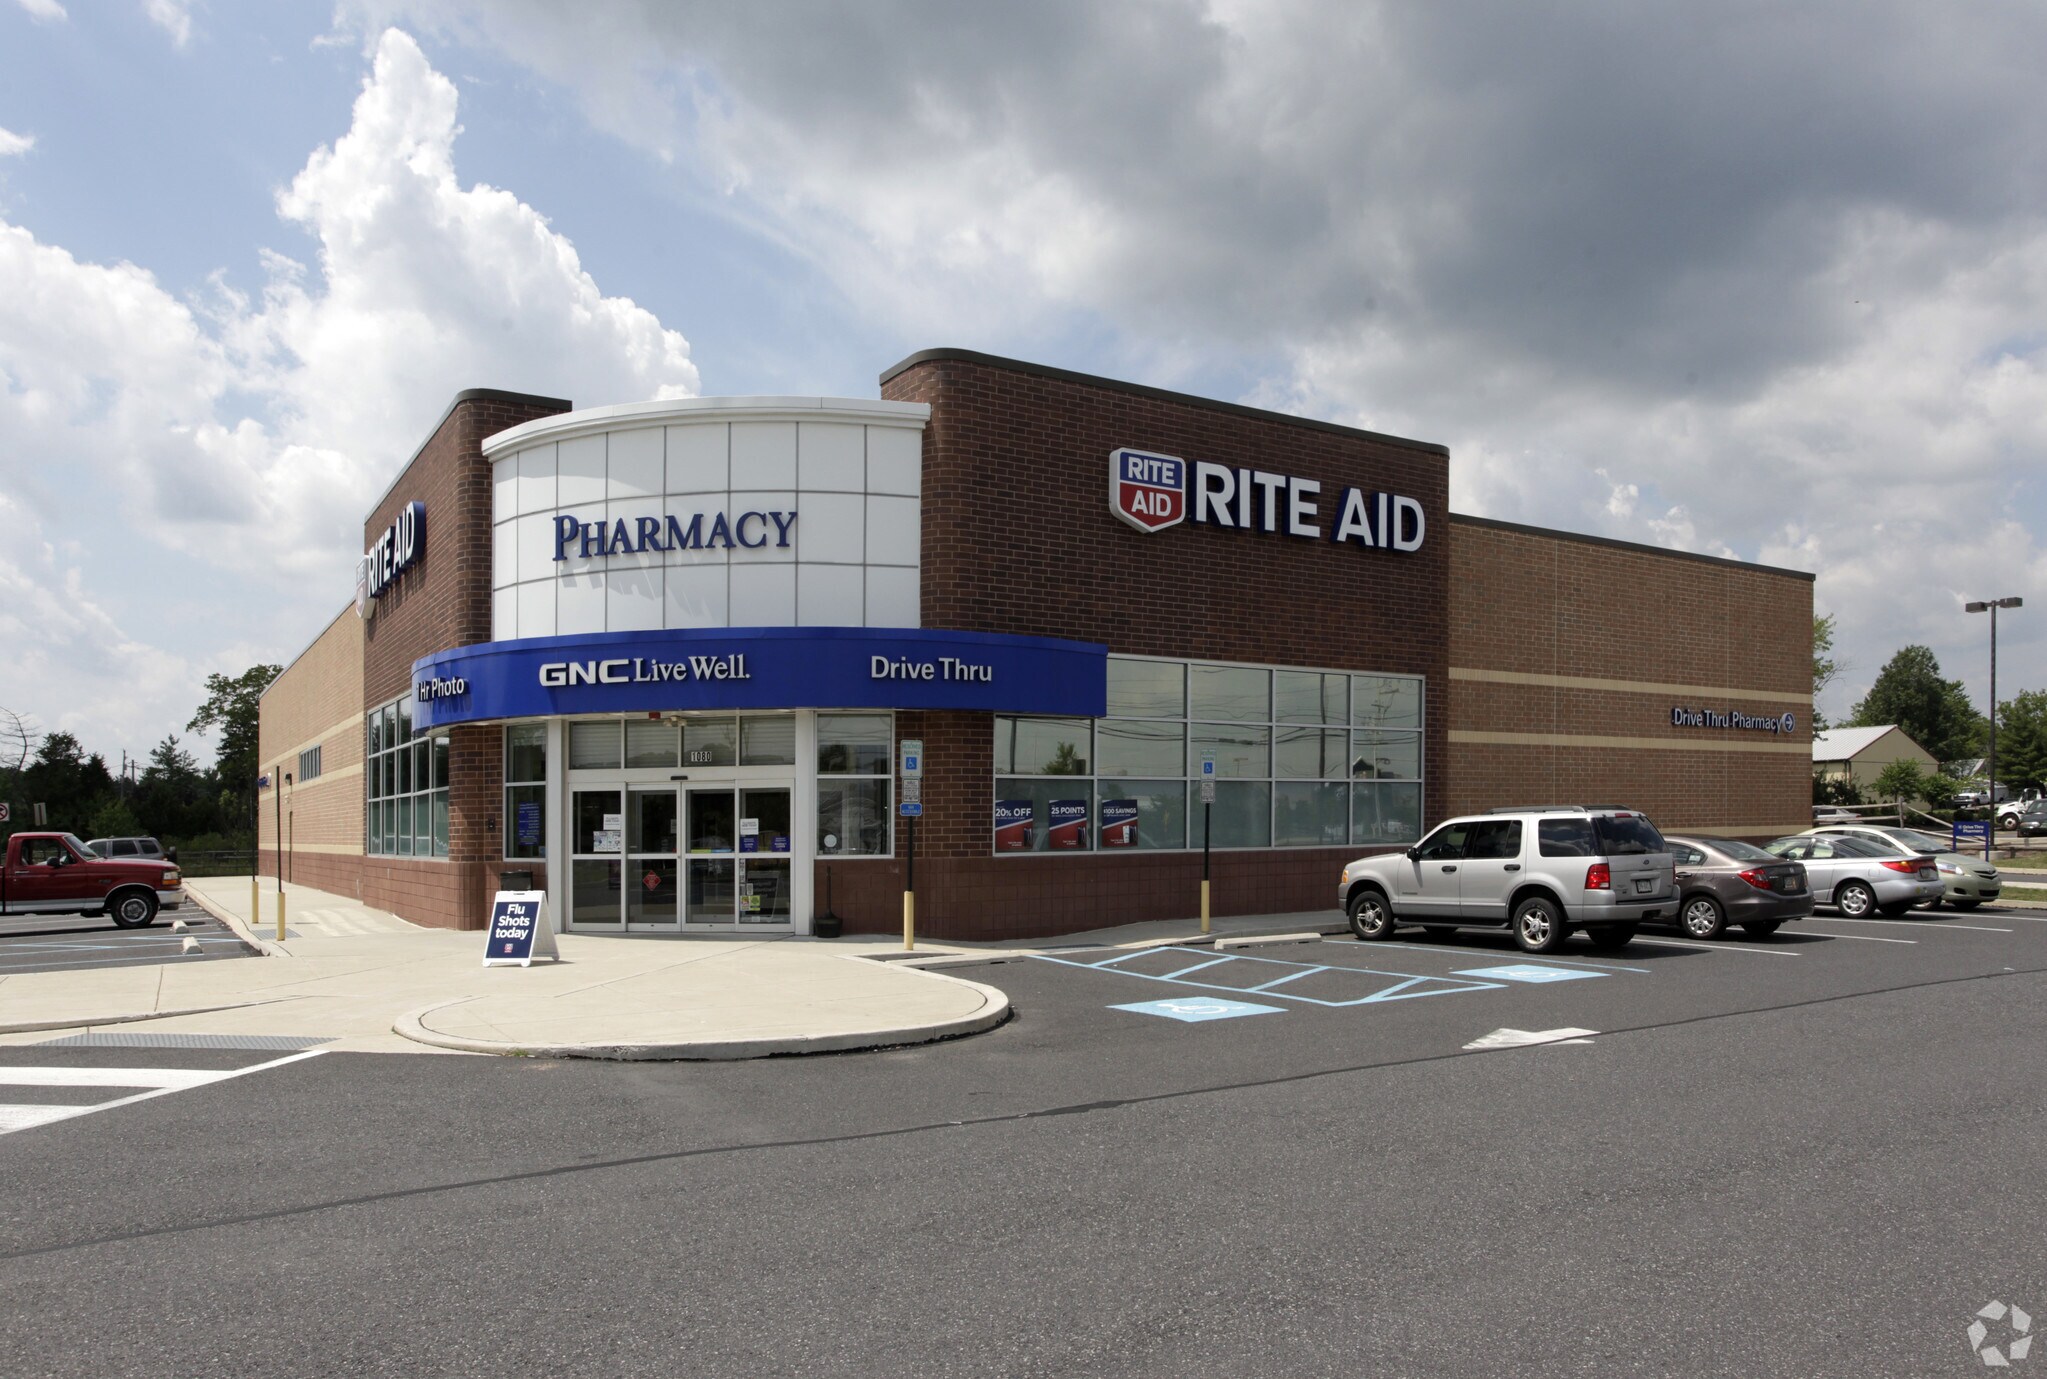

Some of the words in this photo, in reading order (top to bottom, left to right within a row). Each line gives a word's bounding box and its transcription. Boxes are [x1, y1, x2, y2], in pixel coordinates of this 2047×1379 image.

[1127, 456, 1175, 485] RITE
[1131, 490, 1172, 517] AID
[1196, 460, 1321, 538] RITE
[1336, 487, 1426, 552] AID
[368, 526, 391, 598] RITE
[393, 501, 415, 575] AID
[552, 511, 798, 562] PHARMACY
[540, 658, 629, 687] GNC
[633, 657, 687, 682] Live
[688, 653, 751, 681] Well.
[871, 655, 935, 680] Drive
[938, 657, 993, 682] Thru
[431, 676, 465, 698] Photo
[1674, 708, 1703, 726] Drive
[1704, 709, 1729, 728] Thru
[1732, 711, 1782, 734] Pharmacy
[995, 808, 1012, 817] 20%
[1013, 807, 1032, 817] OFF
[1051, 806, 1060, 815] 25
[1060, 806, 1085, 814] POINTS
[497, 915, 531, 927] Shots
[507, 903, 526, 915] Flu
[495, 927, 529, 940] today
